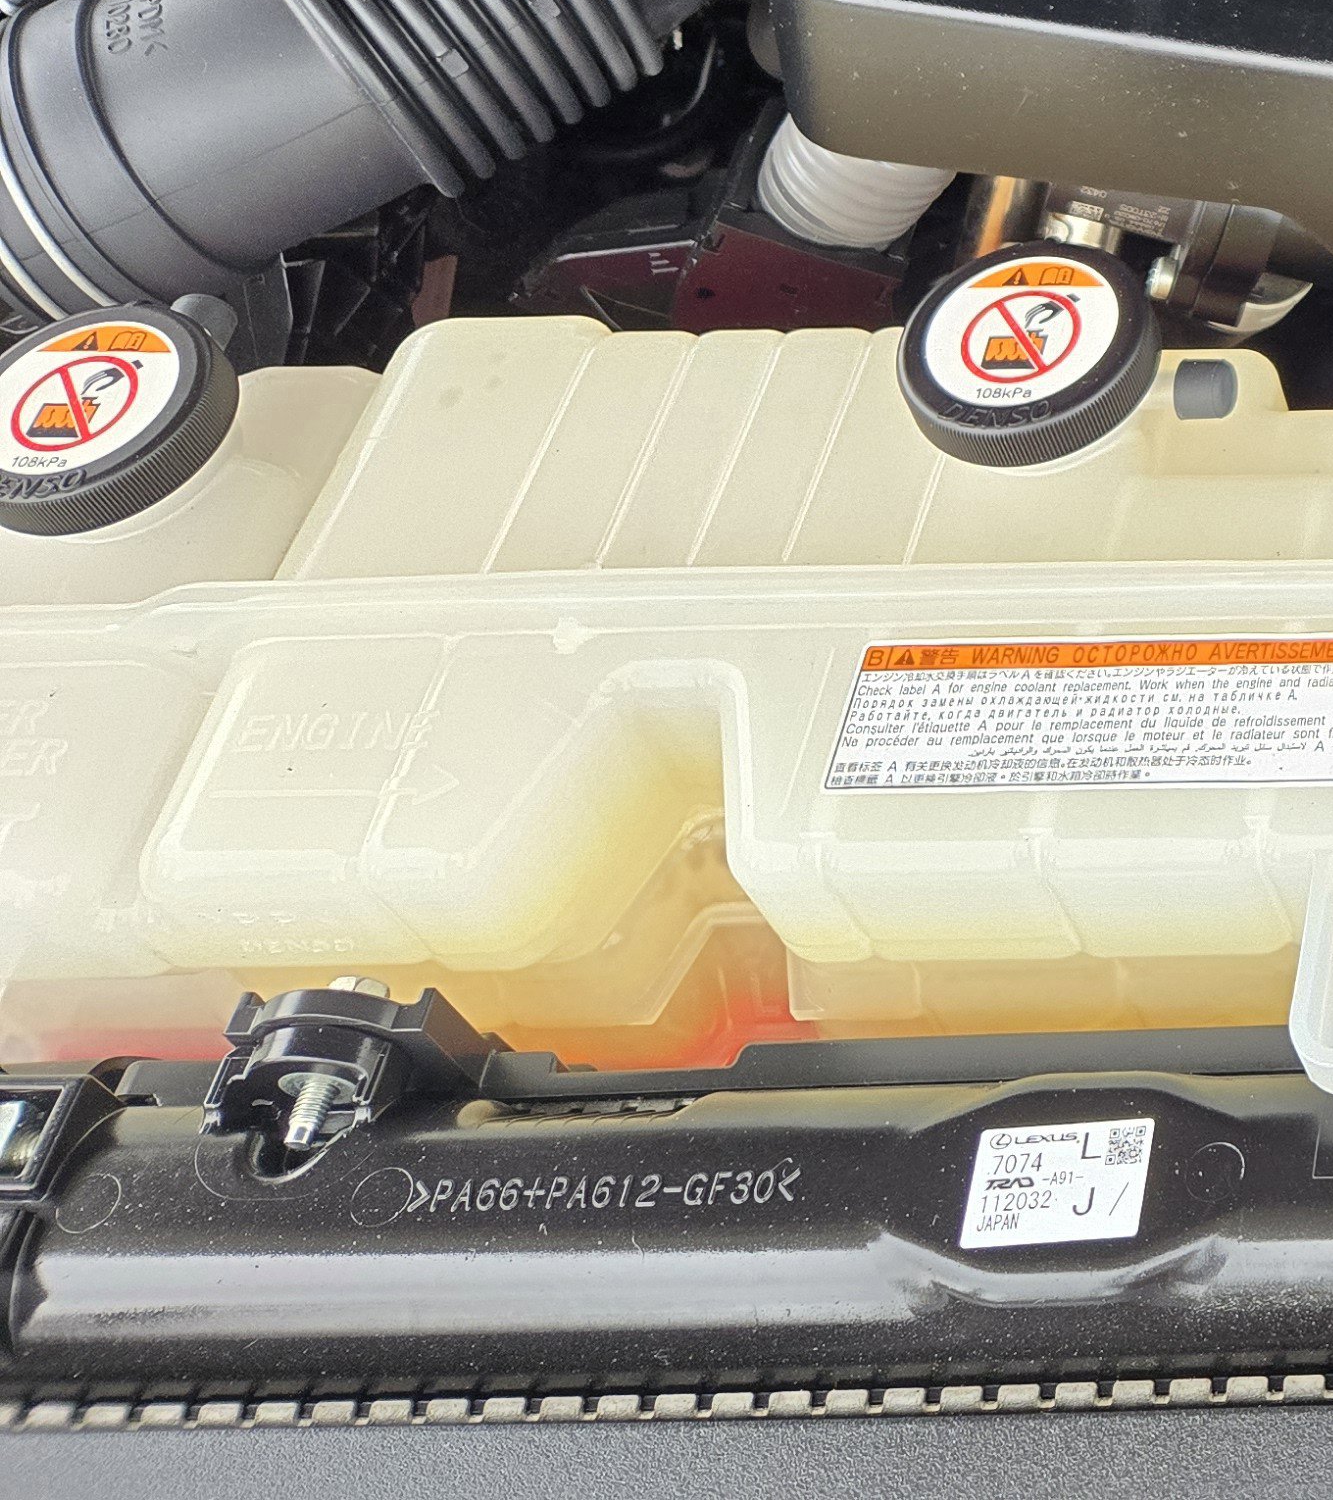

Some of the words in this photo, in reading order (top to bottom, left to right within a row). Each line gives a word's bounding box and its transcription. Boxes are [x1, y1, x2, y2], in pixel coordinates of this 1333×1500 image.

[975, 386, 1033, 400] 108kPa
[937, 401, 1052, 430] DENSO
[11, 455, 68, 469] 108kPa
[0, 468, 88, 500] ENSO
[866, 649, 885, 667] B
[919, 647, 960, 666] 警告
[971, 645, 1060, 666] WARNING
[1072, 643, 1201, 664] ОСТОРОЖНО
[857, 684, 893, 697] Check
[898, 683, 927, 696] label
[931, 683, 941, 695] A
[948, 681, 964, 694] for
[970, 681, 1008, 695] engine
[1014, 681, 1057, 693] coolant
[1062, 680, 1132, 693] replacement.
[1139, 679, 1169, 691] Work
[1175, 678, 1205, 690] when
[1211, 678, 1230, 690] the
[1233, 677, 1273, 692] engine
[1278, 676, 1301, 691] and
[233, 710, 441, 753] ENGINE
[1014, 1132, 1078, 1145] LEXUS
[1080, 1132, 1102, 1160] L
[992, 1152, 1044, 1175] 7074
[407, 1164, 801, 1213] >PA66+PA612-GF30<
[981, 1190, 1052, 1214] 112032
[1072, 1186, 1096, 1216] J
[976, 1212, 1020, 1232] JAPAN
